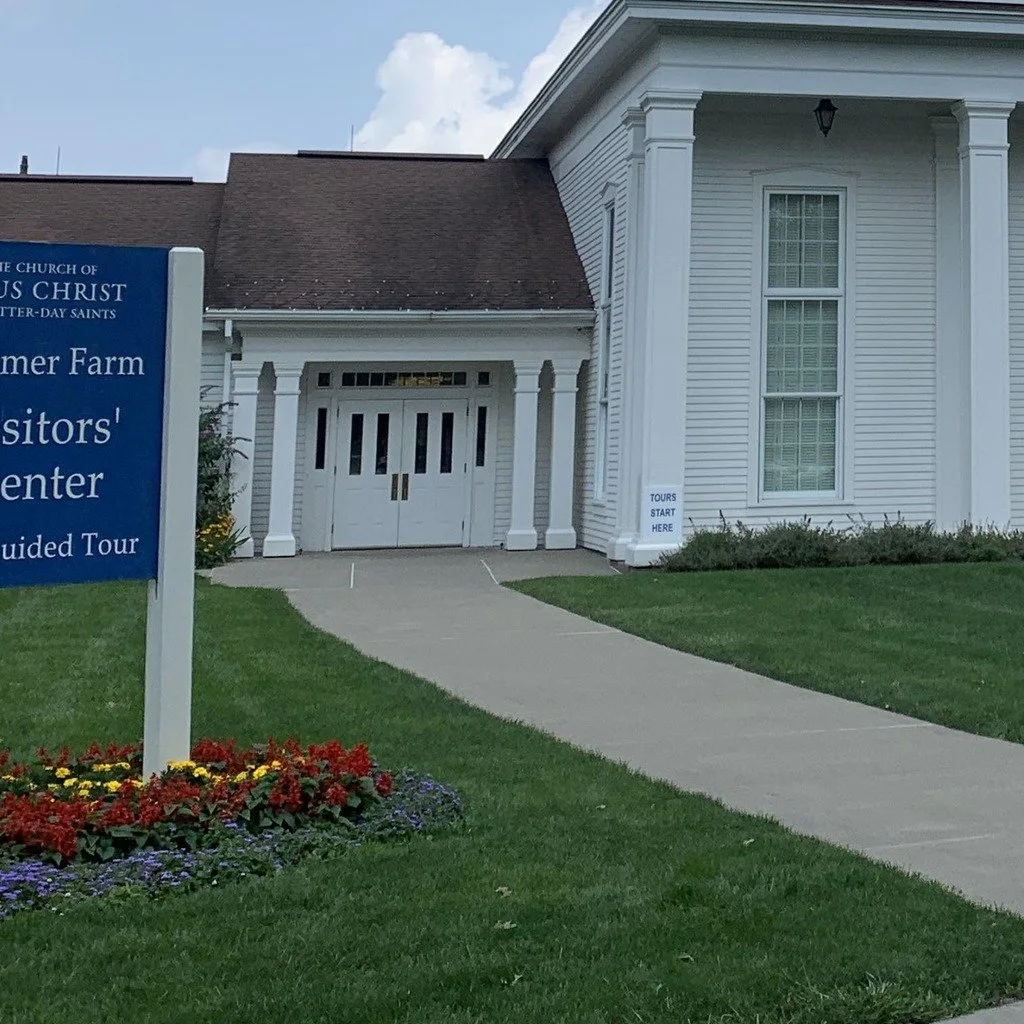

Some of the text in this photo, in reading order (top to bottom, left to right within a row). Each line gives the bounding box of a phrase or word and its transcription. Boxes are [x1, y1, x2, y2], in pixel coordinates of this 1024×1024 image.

[16, 262, 77, 275] CHURCH
[80, 264, 99, 276] OF
[32, 281, 127, 302] CHRIST
[70, 308, 117, 320] SAINTS
[0, 347, 145, 375] mer Farm
[2, 407, 120, 445] sitors'
[1, 466, 104, 501] enter
[650, 493, 677, 502] TOURS
[650, 508, 676, 517] START
[651, 523, 674, 532] HERE
[1, 532, 140, 561] uided Tour
